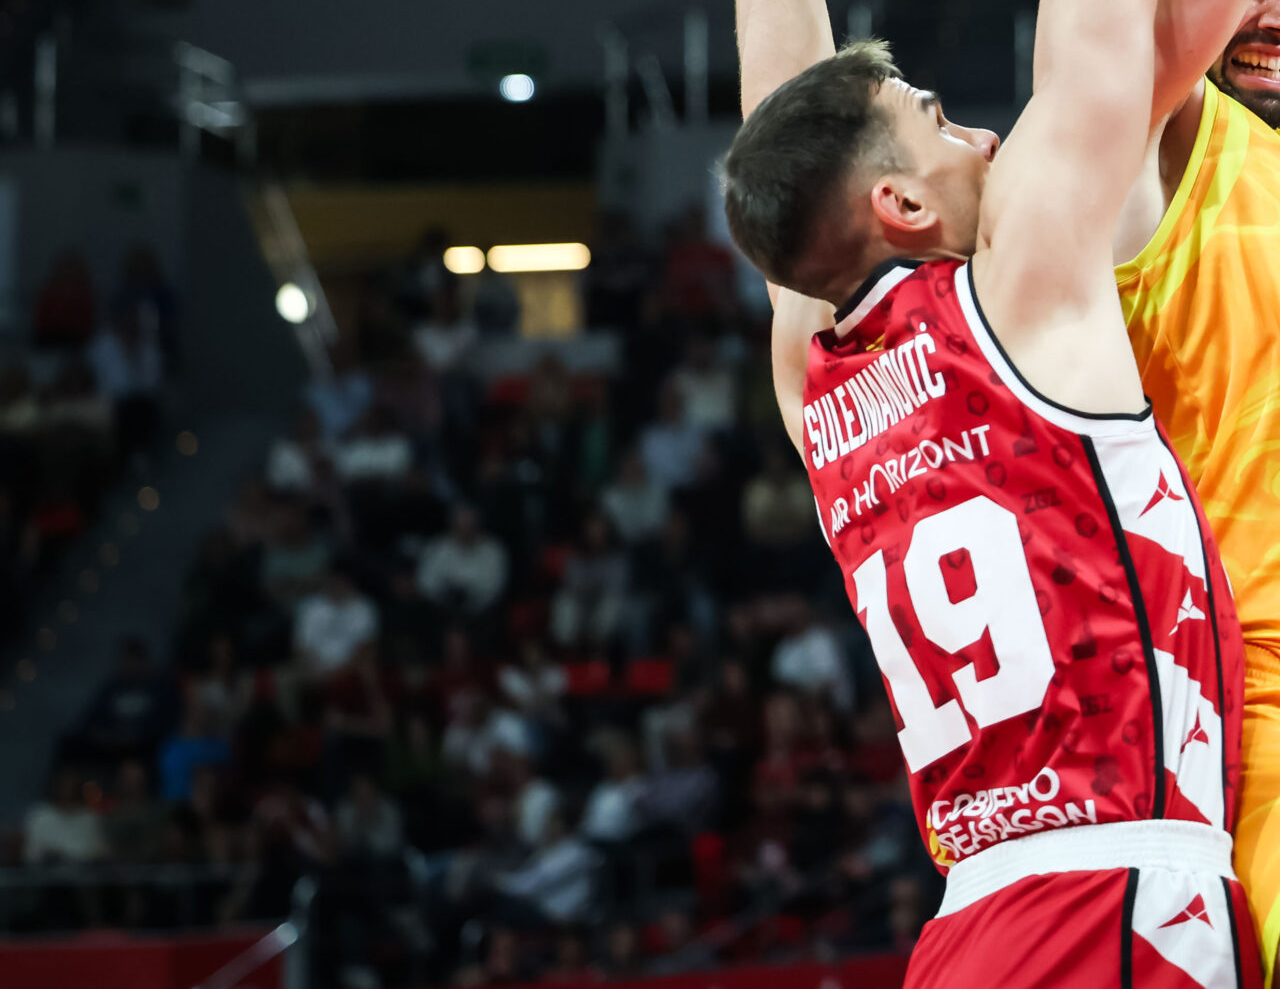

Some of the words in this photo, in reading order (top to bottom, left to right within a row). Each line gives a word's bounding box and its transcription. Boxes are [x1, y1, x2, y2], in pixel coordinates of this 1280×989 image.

[830, 497, 851, 538] AIR
[853, 424, 990, 516] HORIZONT
[853, 494, 1056, 775] 19
